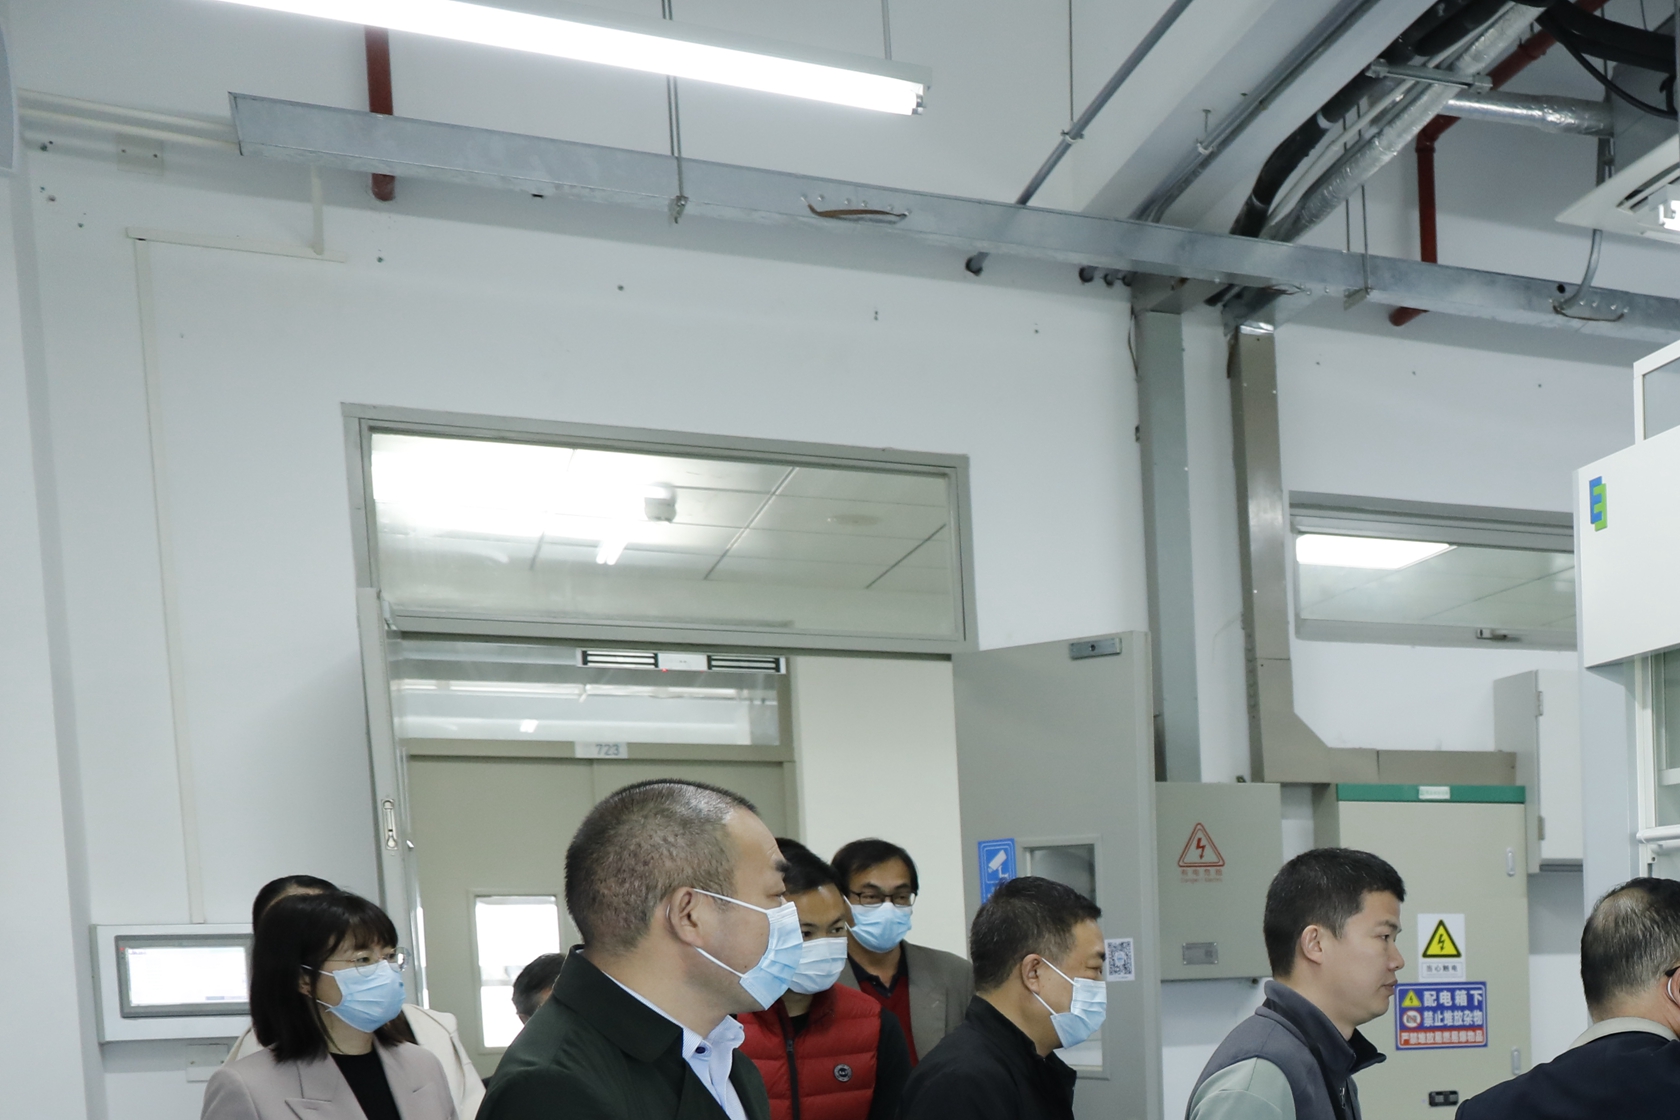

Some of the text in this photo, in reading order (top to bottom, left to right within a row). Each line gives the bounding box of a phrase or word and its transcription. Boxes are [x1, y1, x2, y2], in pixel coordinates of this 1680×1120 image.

[595, 744, 621, 756] 723
[1423, 989, 1483, 1007] 配电箱下
[1423, 1009, 1483, 1027] 禁止堆放杂物
